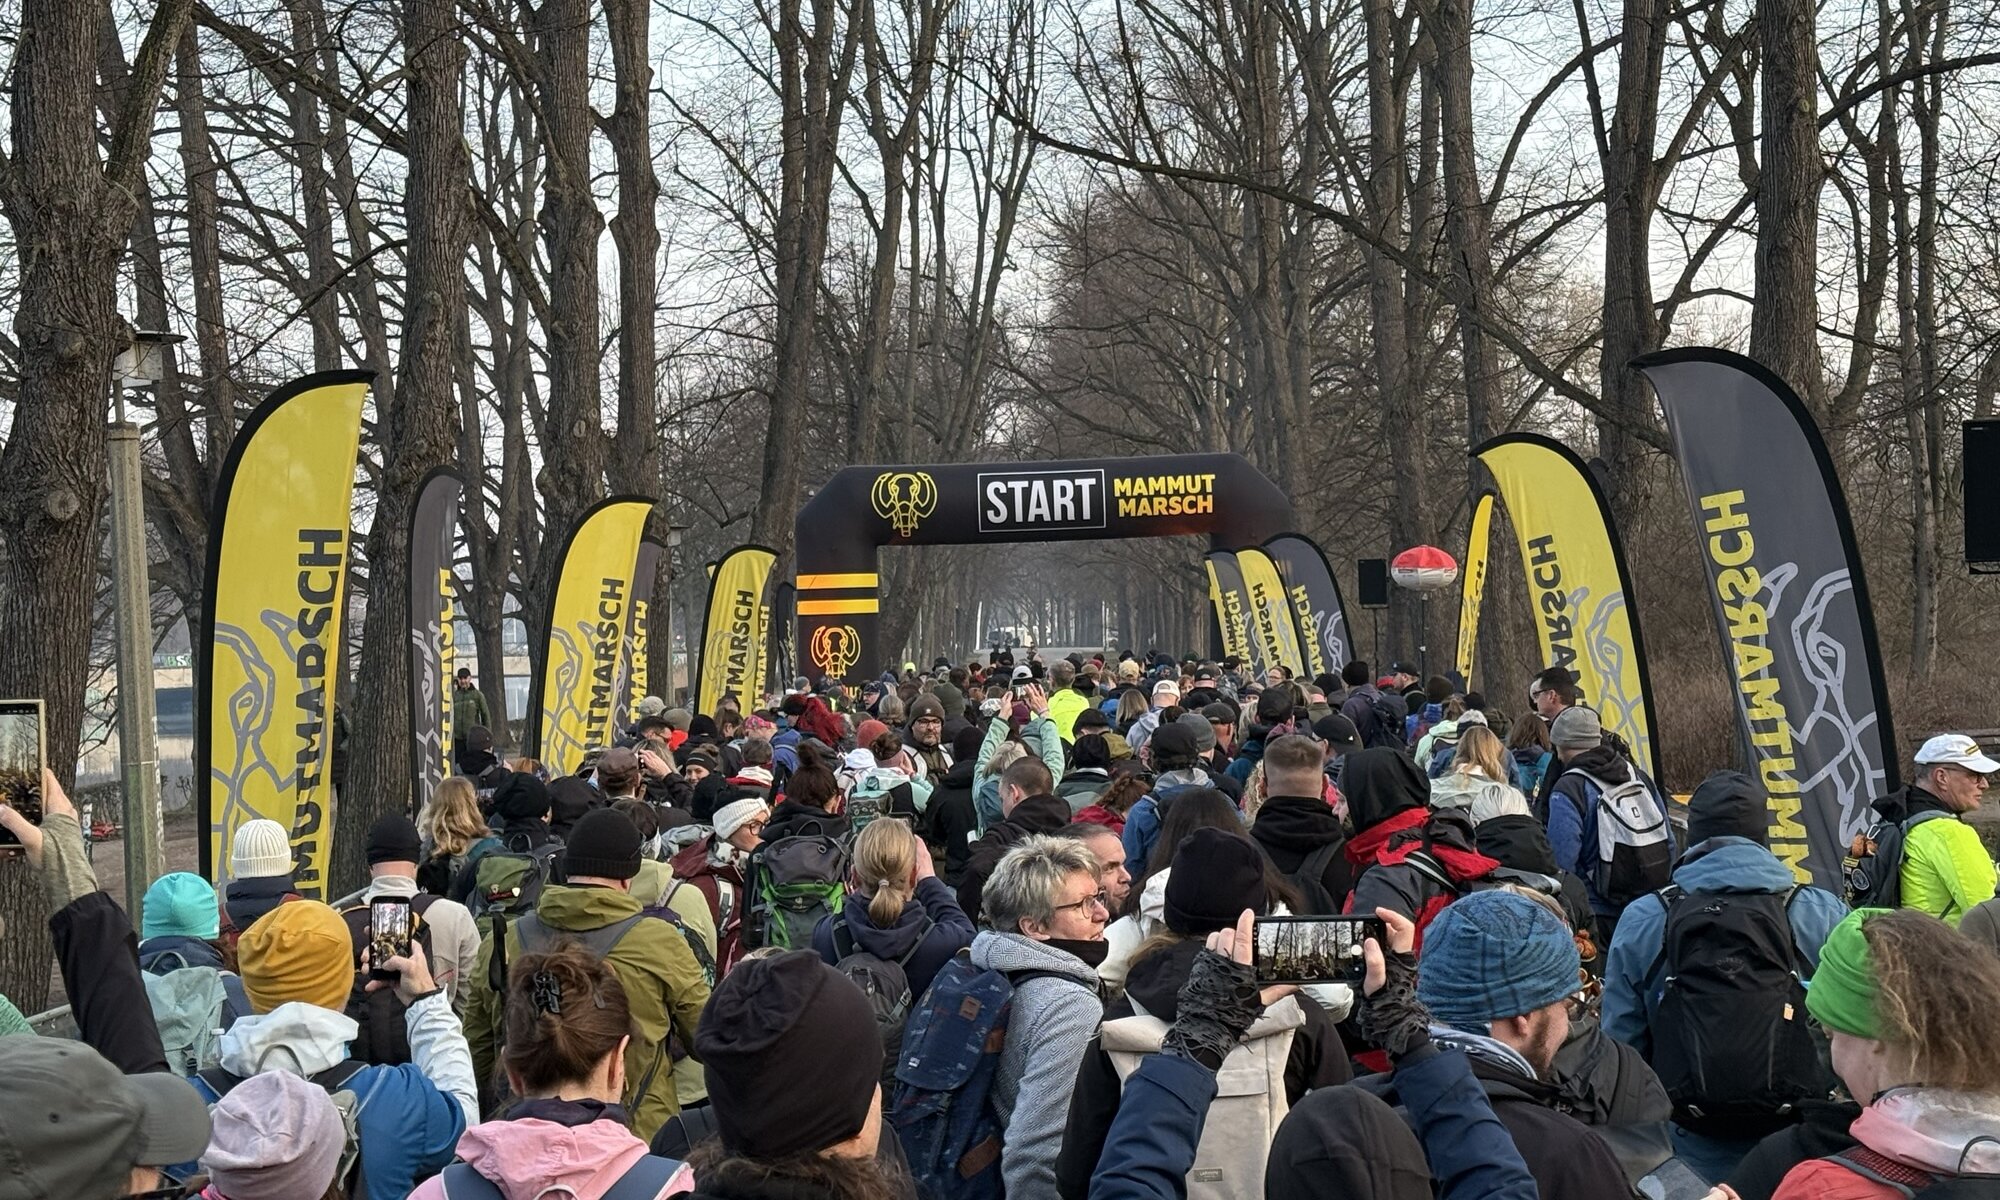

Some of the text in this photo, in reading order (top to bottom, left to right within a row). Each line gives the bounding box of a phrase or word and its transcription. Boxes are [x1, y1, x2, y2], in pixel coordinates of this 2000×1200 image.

[986, 477, 1096, 524] START
[1113, 474, 1216, 497] MAMMUT
[1118, 495, 1213, 518] MARSCH
[585, 578, 625, 750] UTMARSCH
[725, 590, 754, 698] TMARSCH
[290, 529, 343, 899] MUTMARSCH
